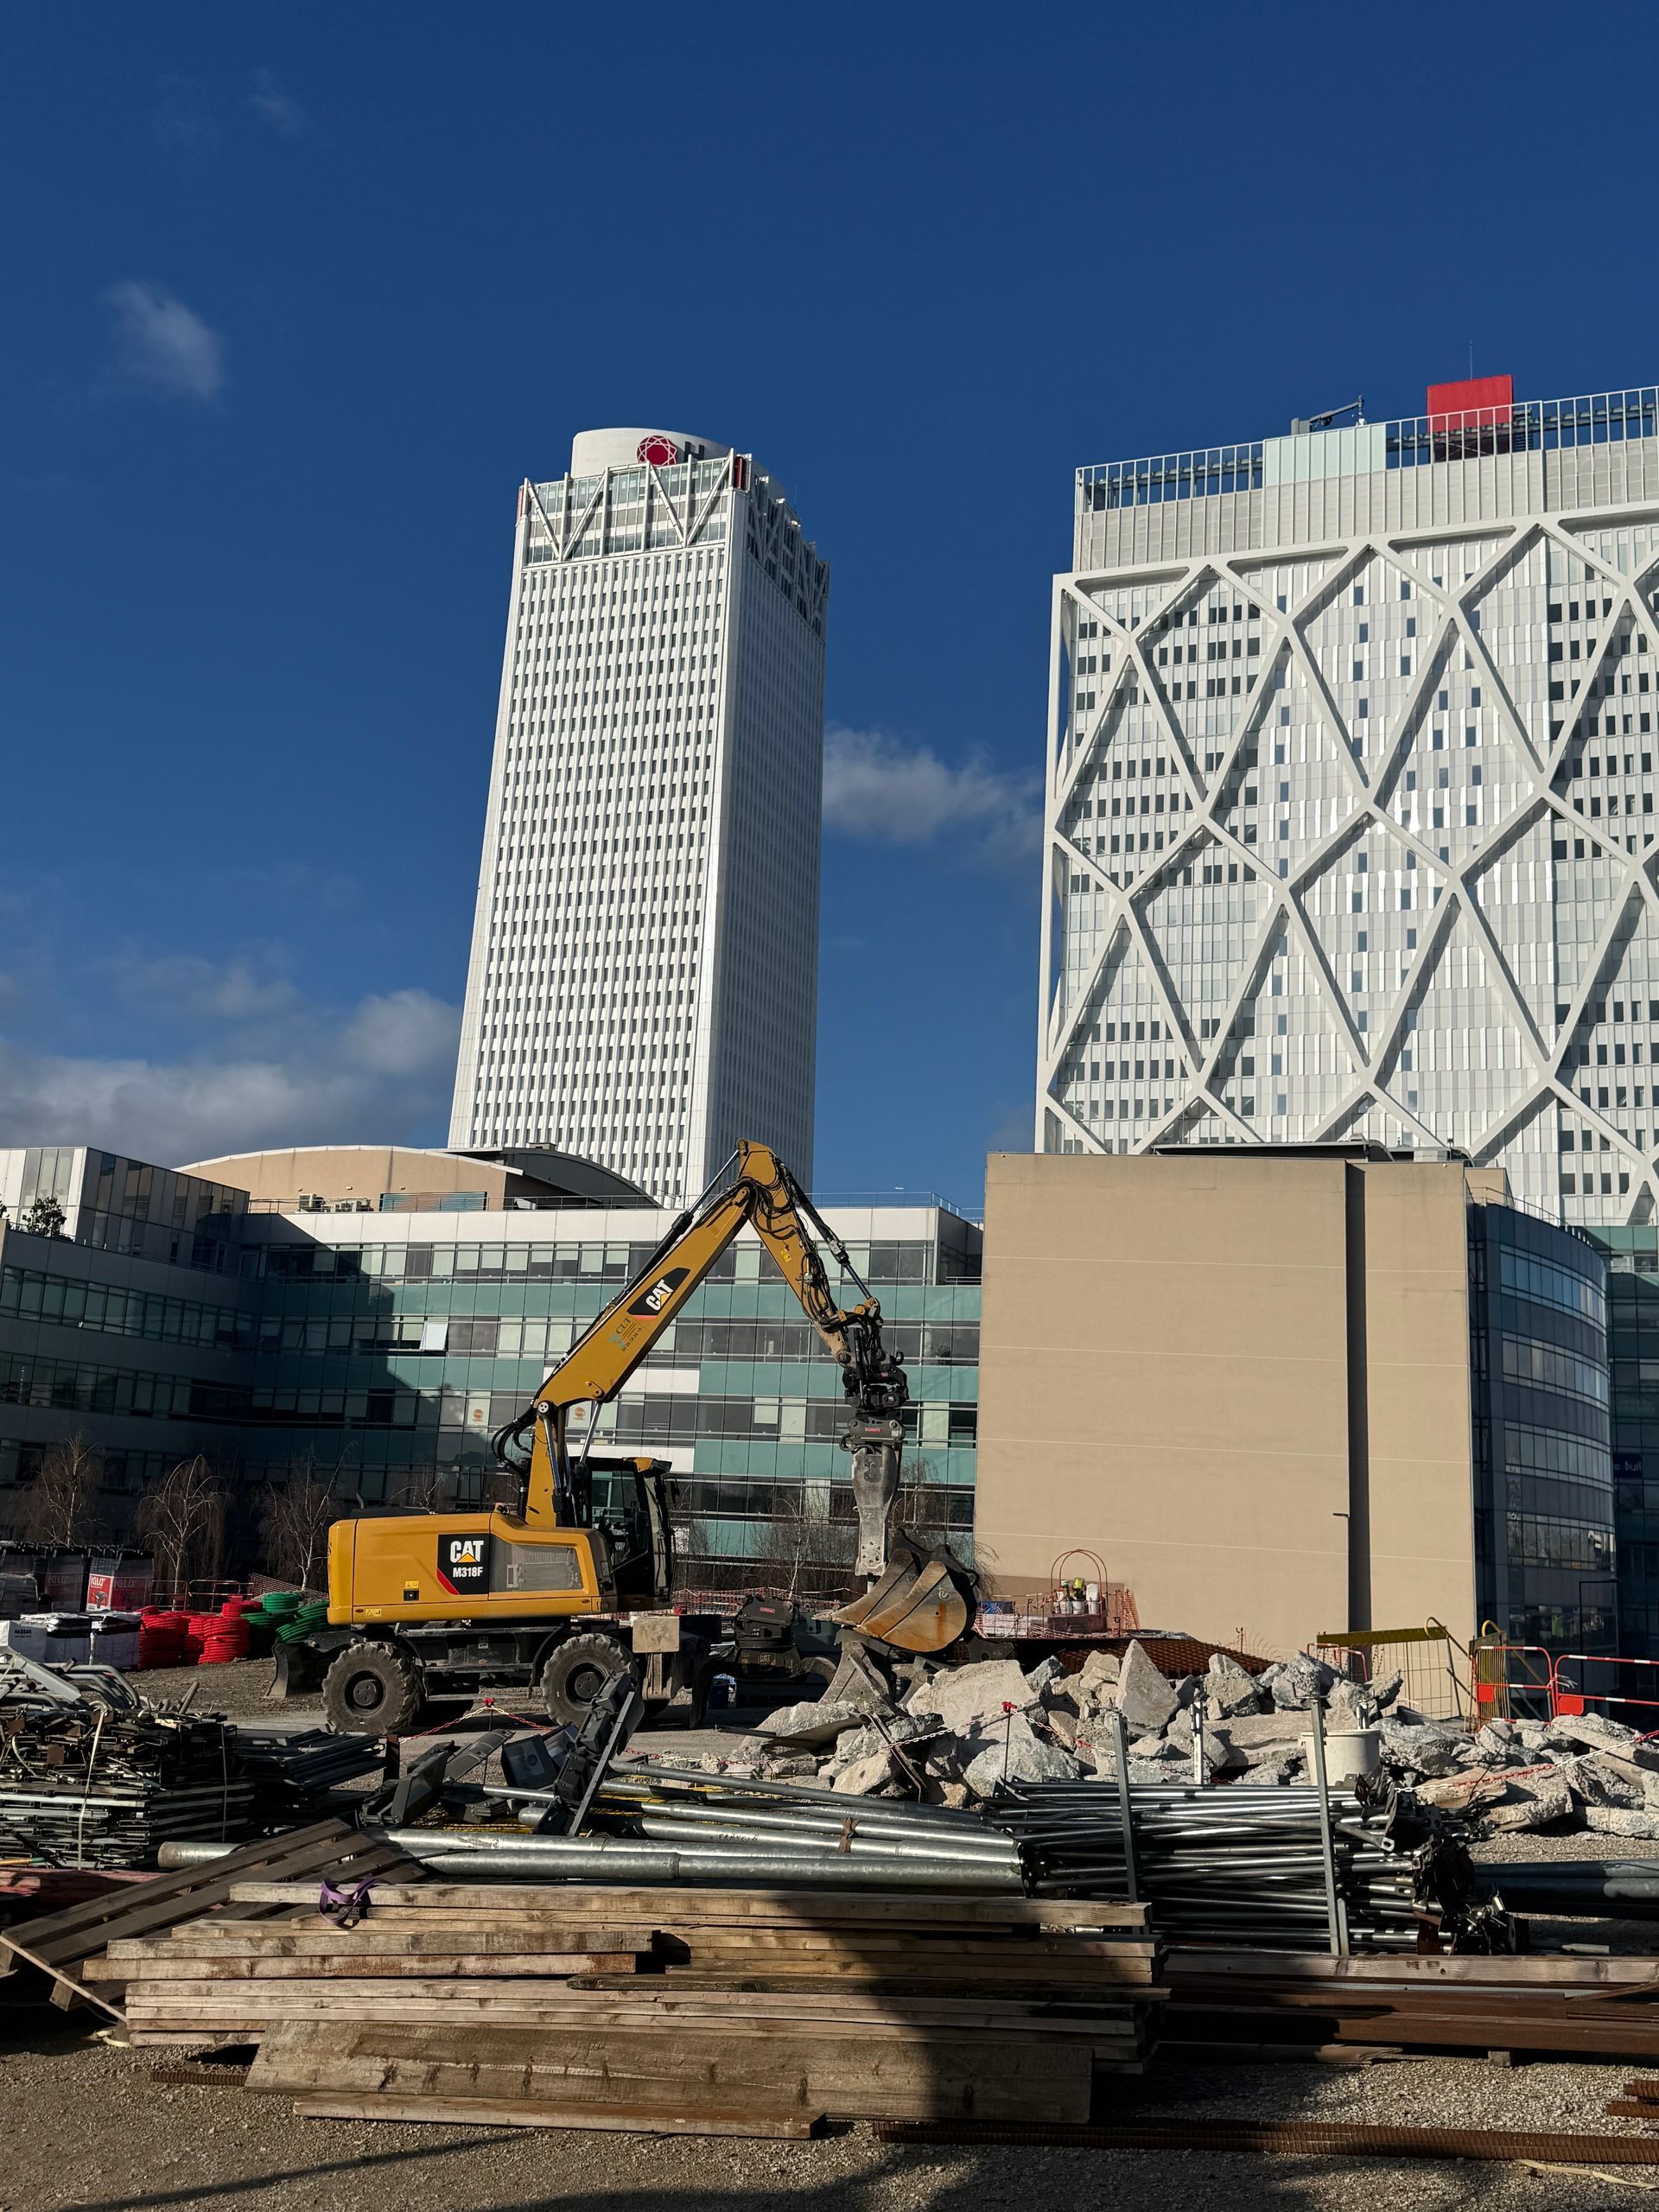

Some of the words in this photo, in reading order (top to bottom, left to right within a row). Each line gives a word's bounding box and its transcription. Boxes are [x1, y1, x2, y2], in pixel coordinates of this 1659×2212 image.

[645, 1279, 674, 1311] CAT
[449, 1540, 485, 1563] CAT
[452, 1567, 484, 1578] M318F
